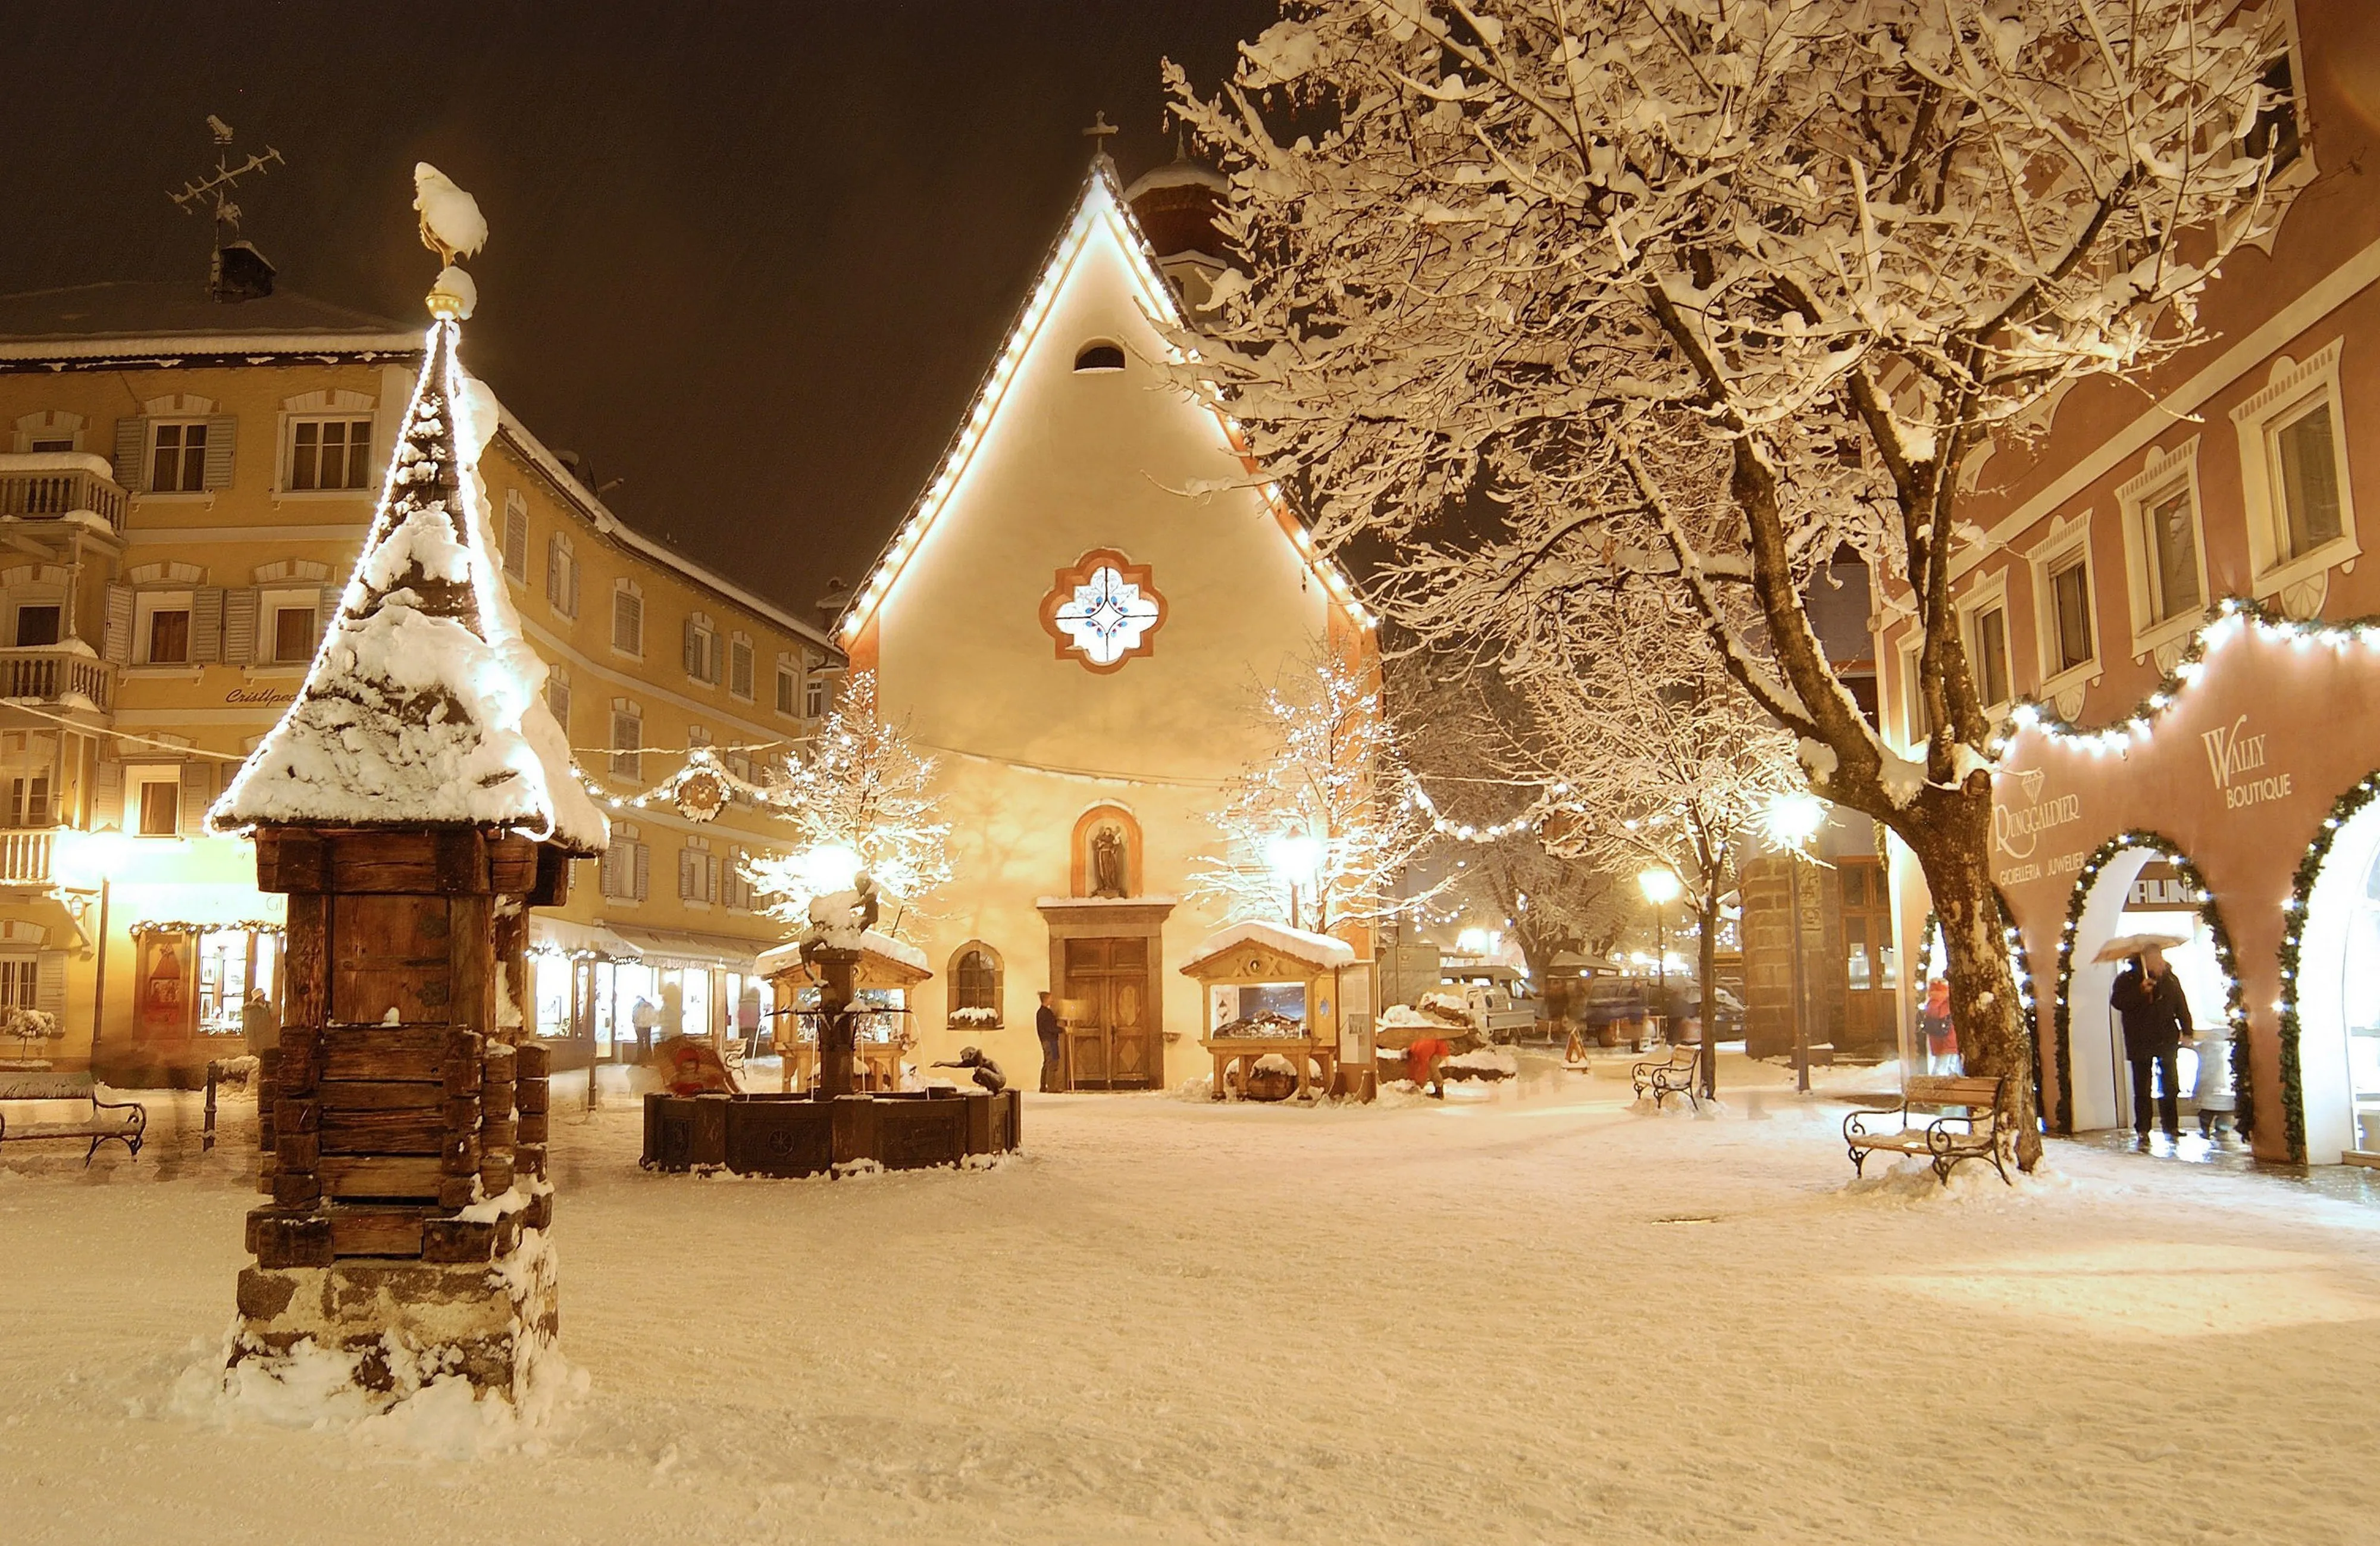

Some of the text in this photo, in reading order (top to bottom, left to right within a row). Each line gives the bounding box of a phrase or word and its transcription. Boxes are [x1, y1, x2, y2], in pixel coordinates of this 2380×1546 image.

[2226, 773, 2292, 809] BOUTIQUE
[1993, 794, 2080, 859] RUNGGALDIER
[2000, 852, 2084, 886] GIOIELLERIA JUWELIER
